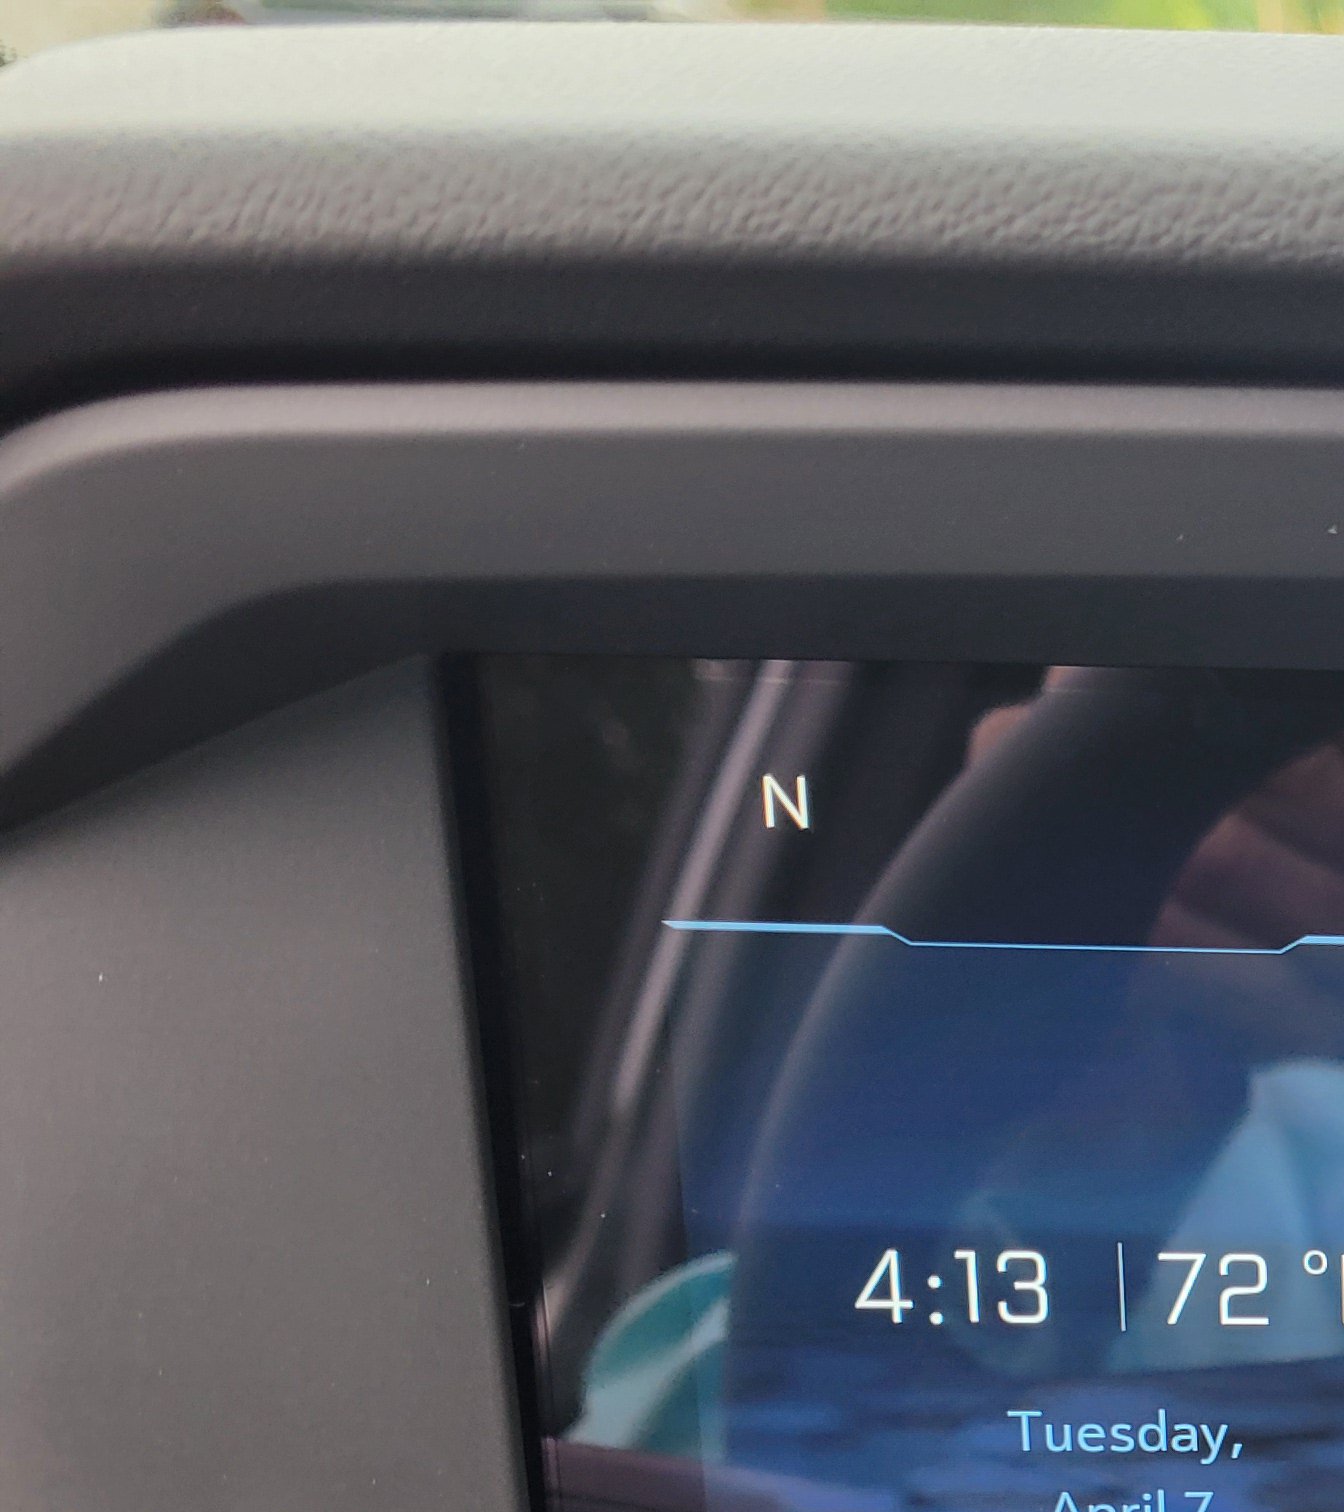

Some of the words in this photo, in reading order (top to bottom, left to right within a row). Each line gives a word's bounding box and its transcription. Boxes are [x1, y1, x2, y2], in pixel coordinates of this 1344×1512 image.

[762, 773, 809, 829] N
[854, 1249, 1049, 1325] 4:13
[1158, 1252, 1270, 1325] 72
[1006, 1408, 1243, 1465] Tuesday,
